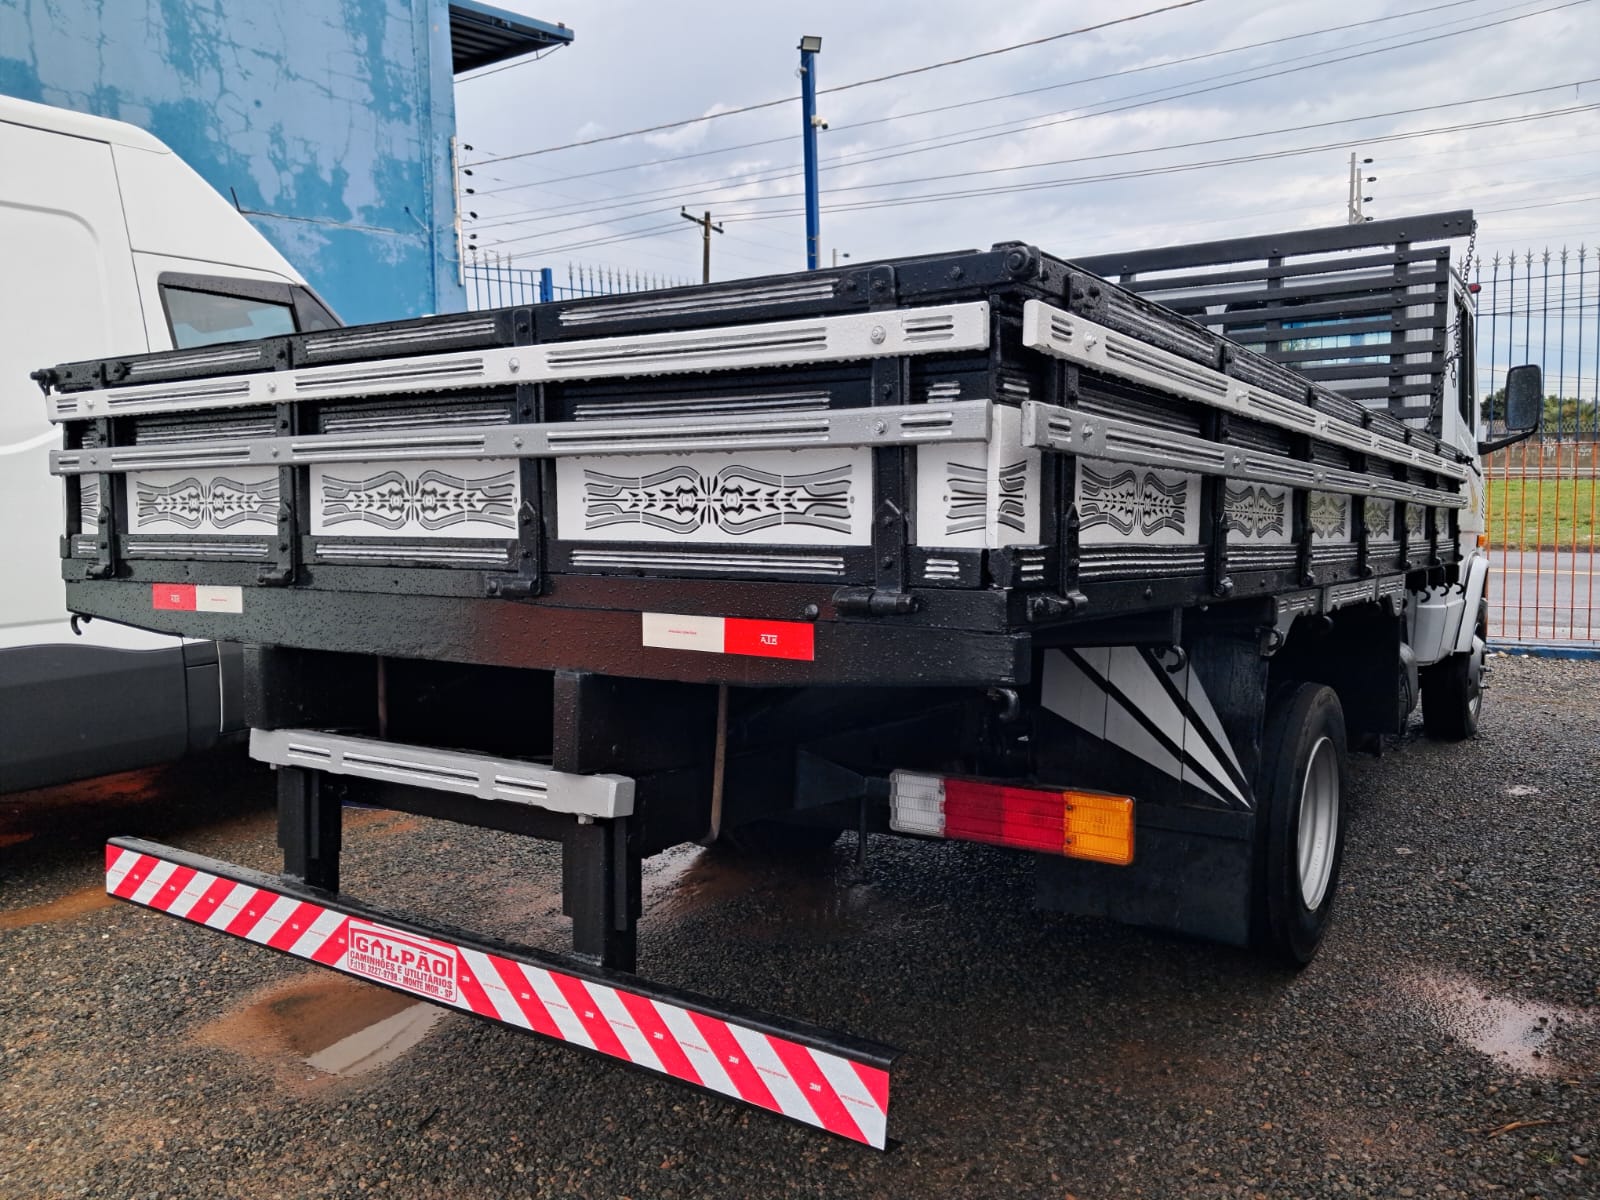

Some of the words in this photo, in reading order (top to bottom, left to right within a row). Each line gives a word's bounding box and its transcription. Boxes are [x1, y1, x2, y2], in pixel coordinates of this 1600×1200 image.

[350, 950, 395, 972] CAMINHÕES
[397, 965, 403, 974] E
[404, 967, 453, 990] UTILITÁRIOS
[355, 936, 447, 977] GALPÃO
[402, 976, 424, 990] MONTE
[425, 983, 439, 995] MOR
[444, 989, 453, 998] SP
[809, 1082, 822, 1092] 3M
